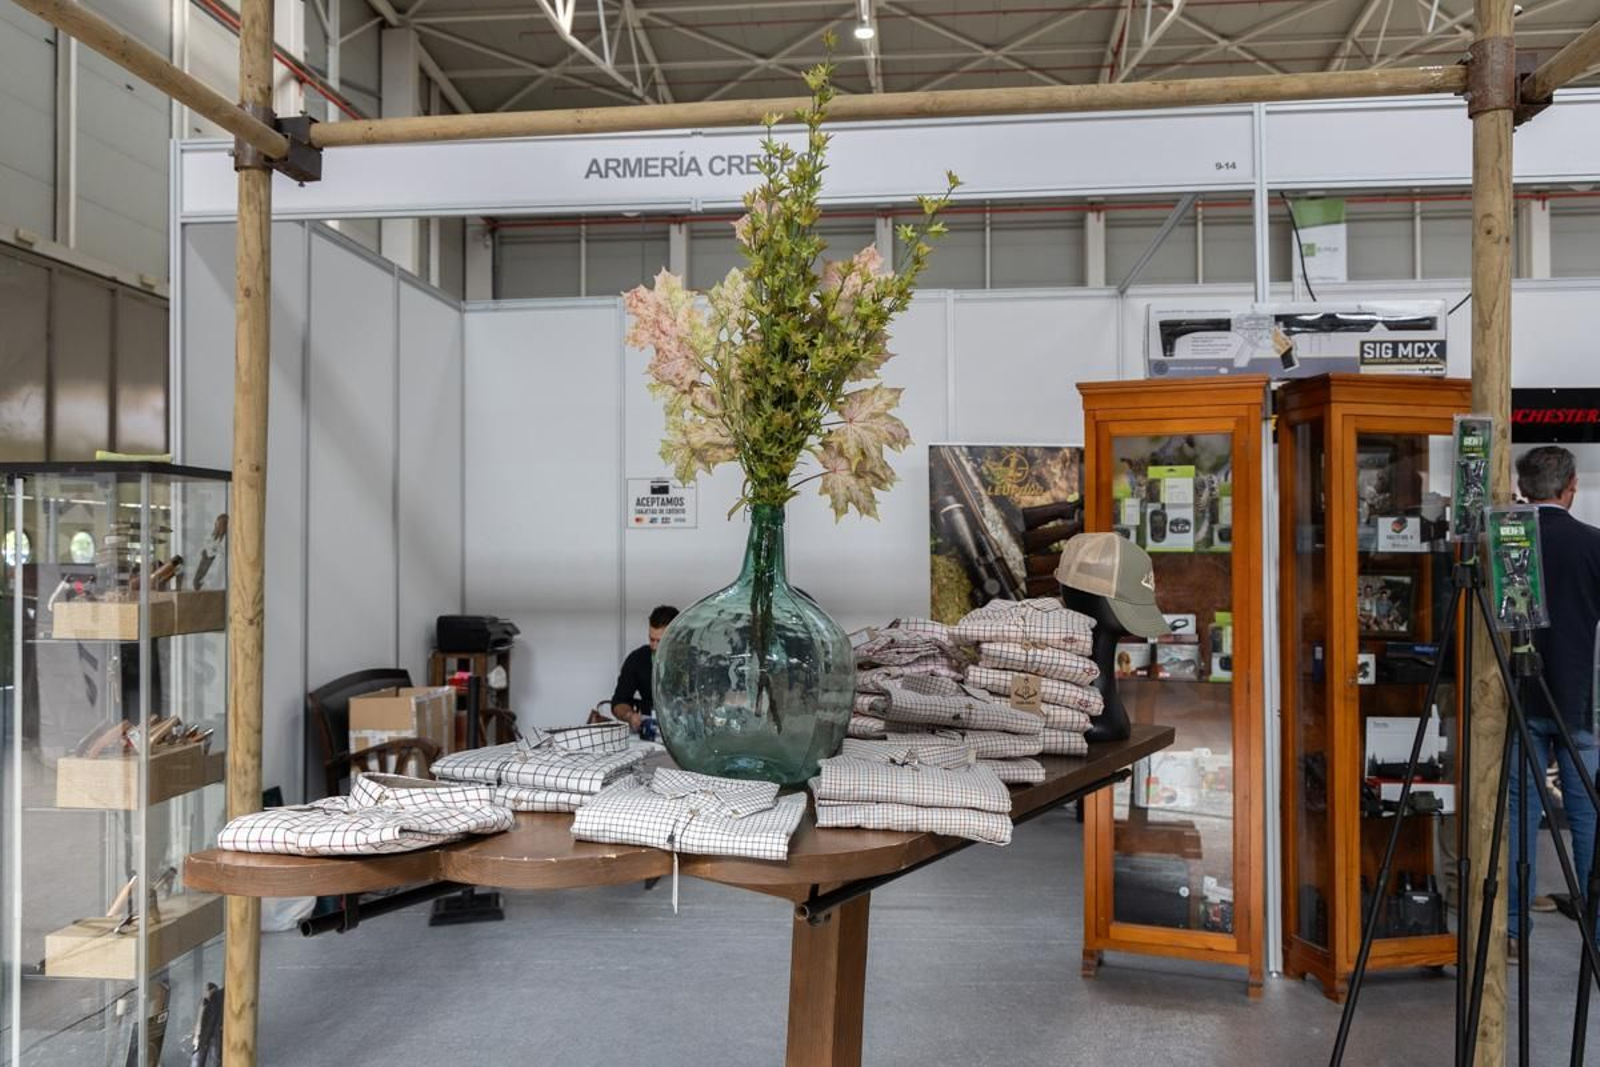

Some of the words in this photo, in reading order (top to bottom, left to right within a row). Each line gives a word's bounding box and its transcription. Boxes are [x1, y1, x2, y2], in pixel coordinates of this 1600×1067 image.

[585, 151, 703, 179] ARMERÍA
[1215, 161, 1237, 170] 9-14
[1363, 342, 1393, 358] SIG
[1398, 342, 1437, 358] MCX
[635, 497, 685, 507] ACEPTAMOS
